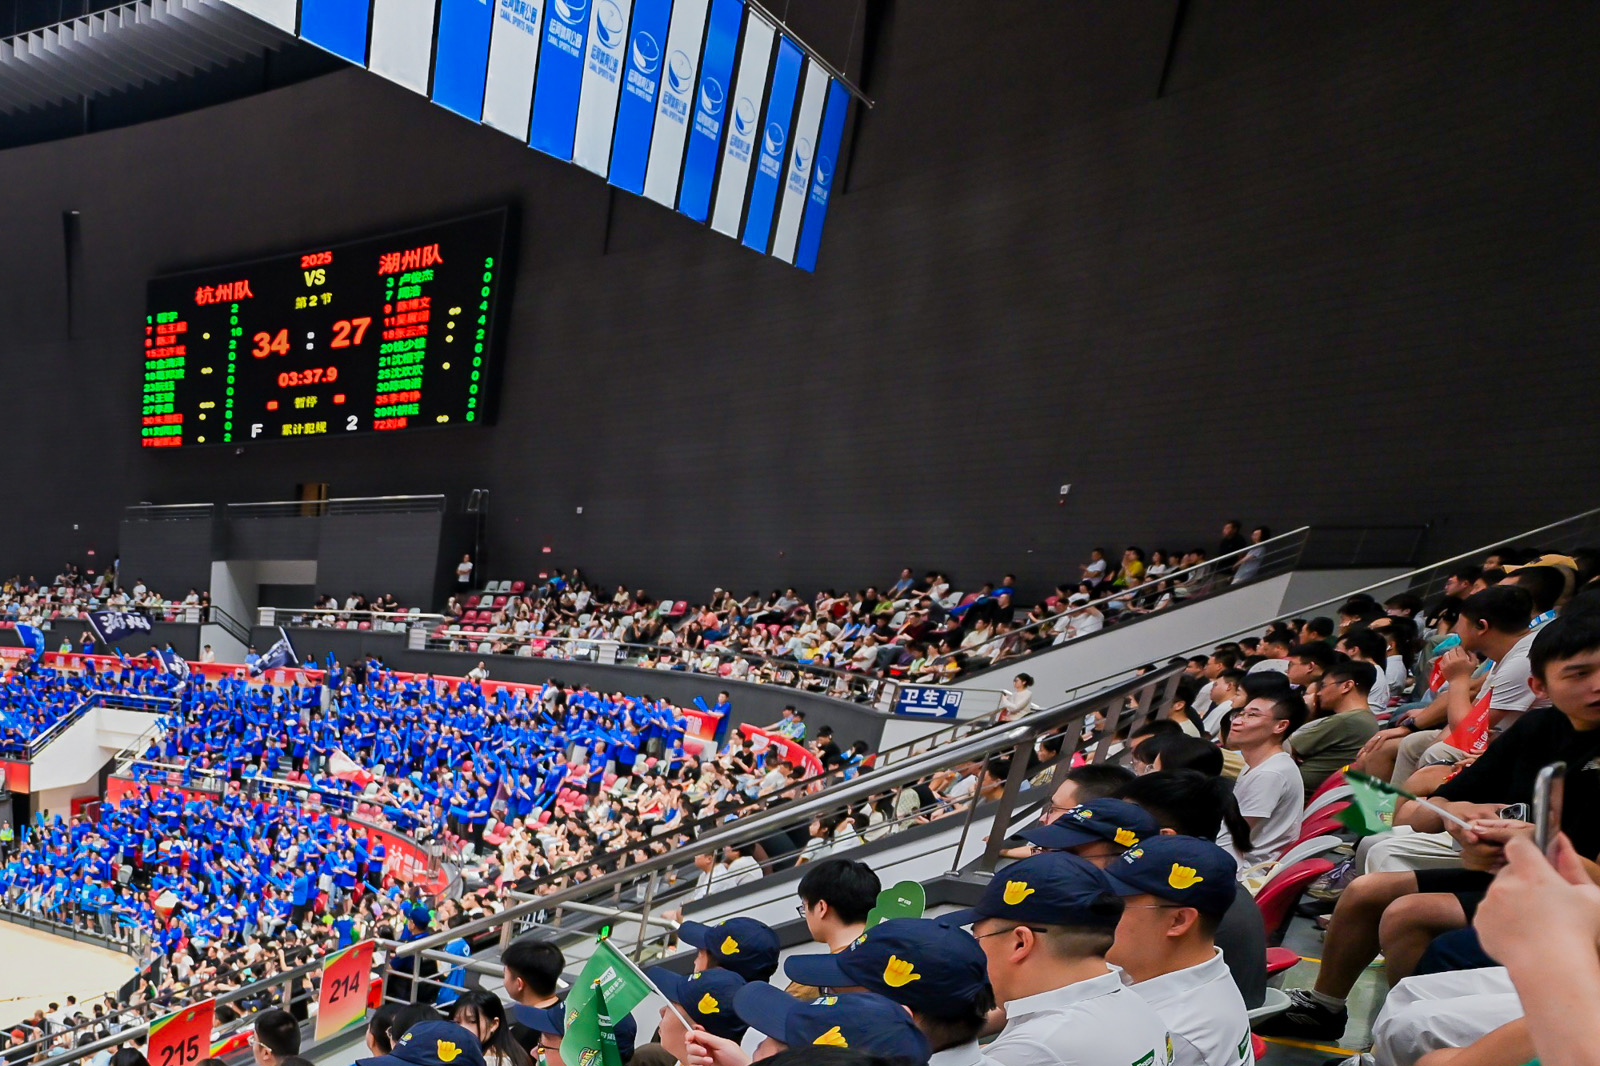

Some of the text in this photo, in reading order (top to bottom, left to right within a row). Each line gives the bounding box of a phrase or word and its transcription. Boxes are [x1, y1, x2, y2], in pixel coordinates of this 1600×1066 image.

[301, 251, 333, 268] 2025
[379, 243, 443, 275] 湖州队
[485, 257, 493, 268] 3
[304, 268, 326, 287] VS
[483, 272, 492, 282] 0
[195, 280, 253, 306] 杭州队
[481, 286, 490, 297] 0
[231, 303, 239, 313] 2
[479, 300, 488, 311] 4
[230, 315, 238, 325] 0
[478, 315, 486, 325] 4
[231, 327, 243, 336] 16
[476, 329, 485, 339] 2
[252, 328, 290, 357] 34
[330, 317, 372, 348] 27
[229, 340, 237, 349] 2
[474, 342, 483, 353] 6
[228, 351, 236, 361] 0
[472, 356, 481, 367] 0
[228, 363, 236, 373] 2
[227, 375, 235, 384] 0
[278, 366, 338, 388] 03:37.9
[471, 370, 479, 381] 0
[226, 387, 234, 396] 0
[469, 384, 478, 394] 0
[225, 398, 233, 408] 2
[468, 397, 476, 408] 2
[225, 410, 233, 419] 8
[466, 411, 474, 421] 6
[224, 421, 232, 430] 0
[251, 423, 264, 438] F
[346, 415, 359, 431] 2
[223, 433, 232, 442] 2
[901, 688, 963, 707] 卫生间
[329, 970, 360, 1004] 214
